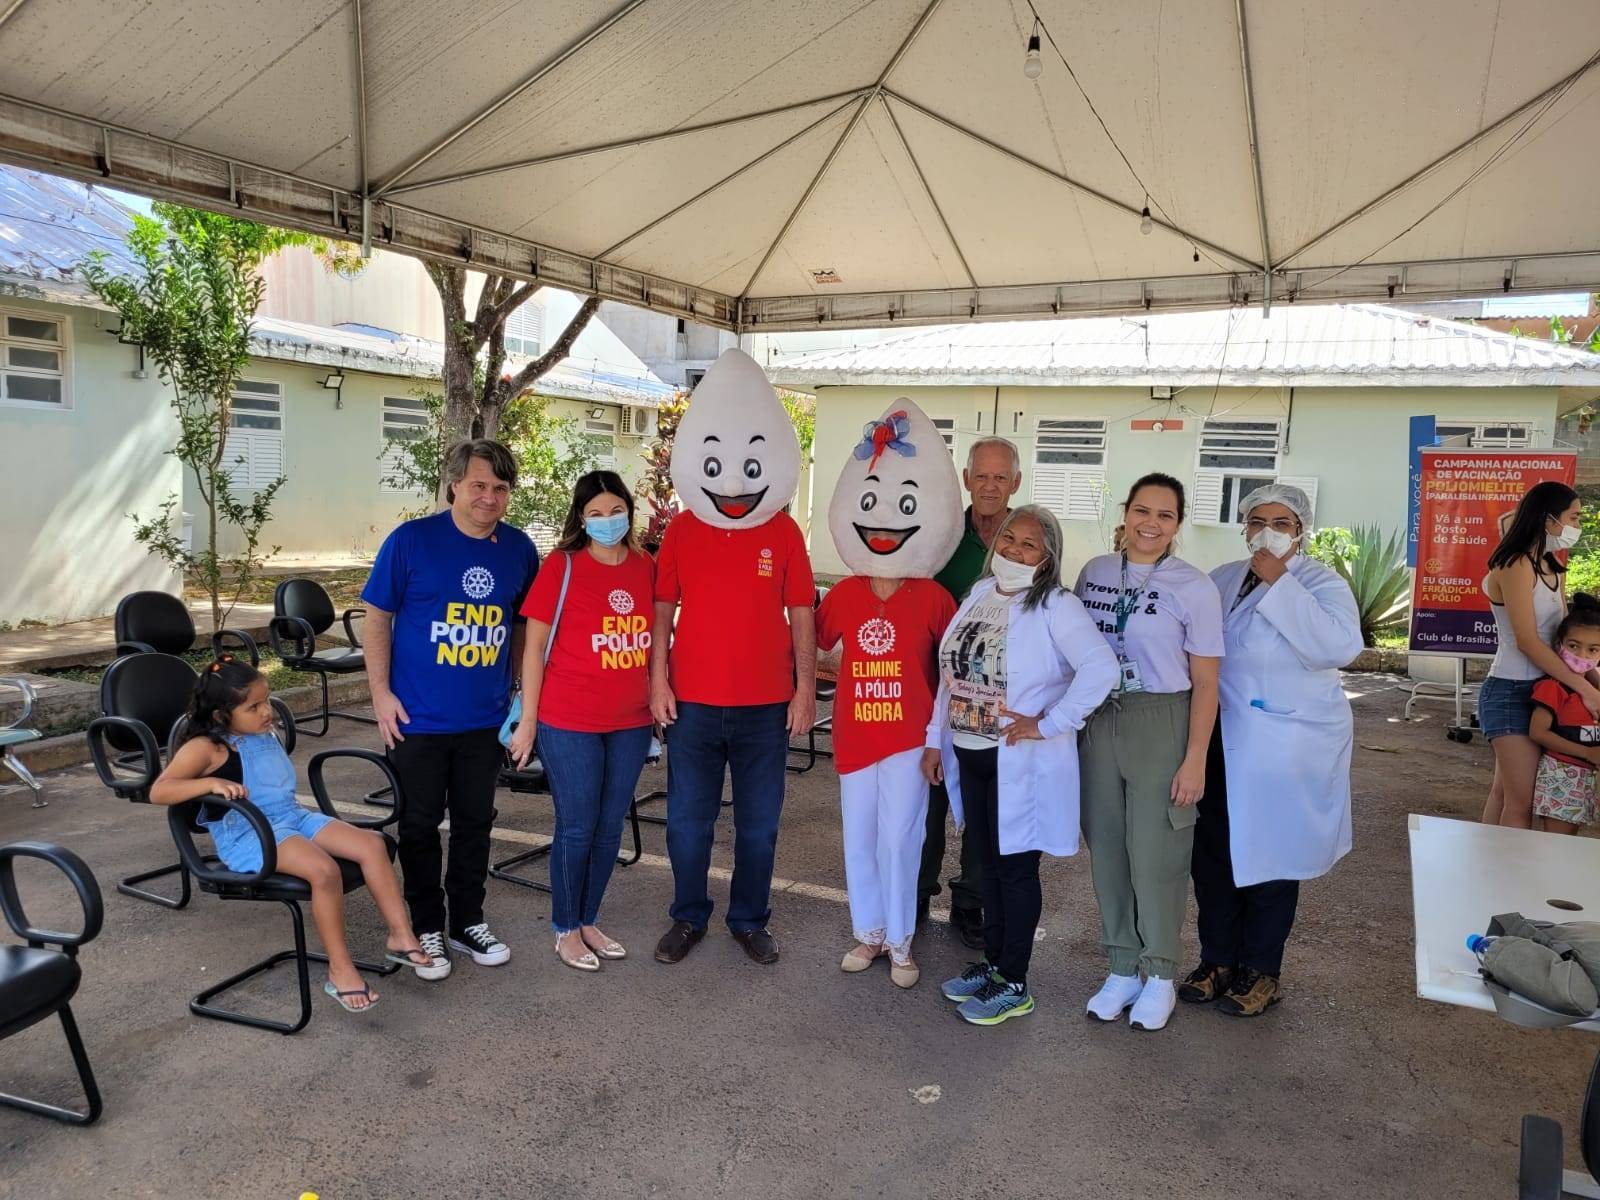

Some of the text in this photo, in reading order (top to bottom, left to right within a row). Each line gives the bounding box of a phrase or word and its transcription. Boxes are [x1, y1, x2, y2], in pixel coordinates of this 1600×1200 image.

[1434, 459, 1564, 470] CAMPANHA NACIONAL
[1437, 469, 1522, 482] DE VACINAÇÃO
[1426, 480, 1525, 492] POLIOMIELITE
[1410, 473, 1422, 542] Para você
[1435, 513, 1483, 525] Vá a um
[1434, 525, 1467, 535] Posto
[1434, 533, 1488, 545] de Saúde
[1423, 577, 1472, 586] EU QUERO
[1148, 591, 1160, 600] &
[1422, 585, 1478, 595] ERRADICAR
[1422, 593, 1461, 603] A PÓLIO
[446, 602, 503, 627] END
[1144, 603, 1157, 615] &
[602, 615, 647, 635] END
[1474, 621, 1498, 634] Rot
[430, 620, 507, 648] POLIO
[1417, 632, 1438, 641] Club
[1441, 634, 1453, 642] de
[591, 631, 652, 653] POLIO
[436, 642, 500, 667] NOW
[601, 649, 646, 670] NOW
[852, 661, 902, 678] ELIMINE
[855, 678, 902, 699] A PÓLIO
[854, 702, 903, 722] AGORA
